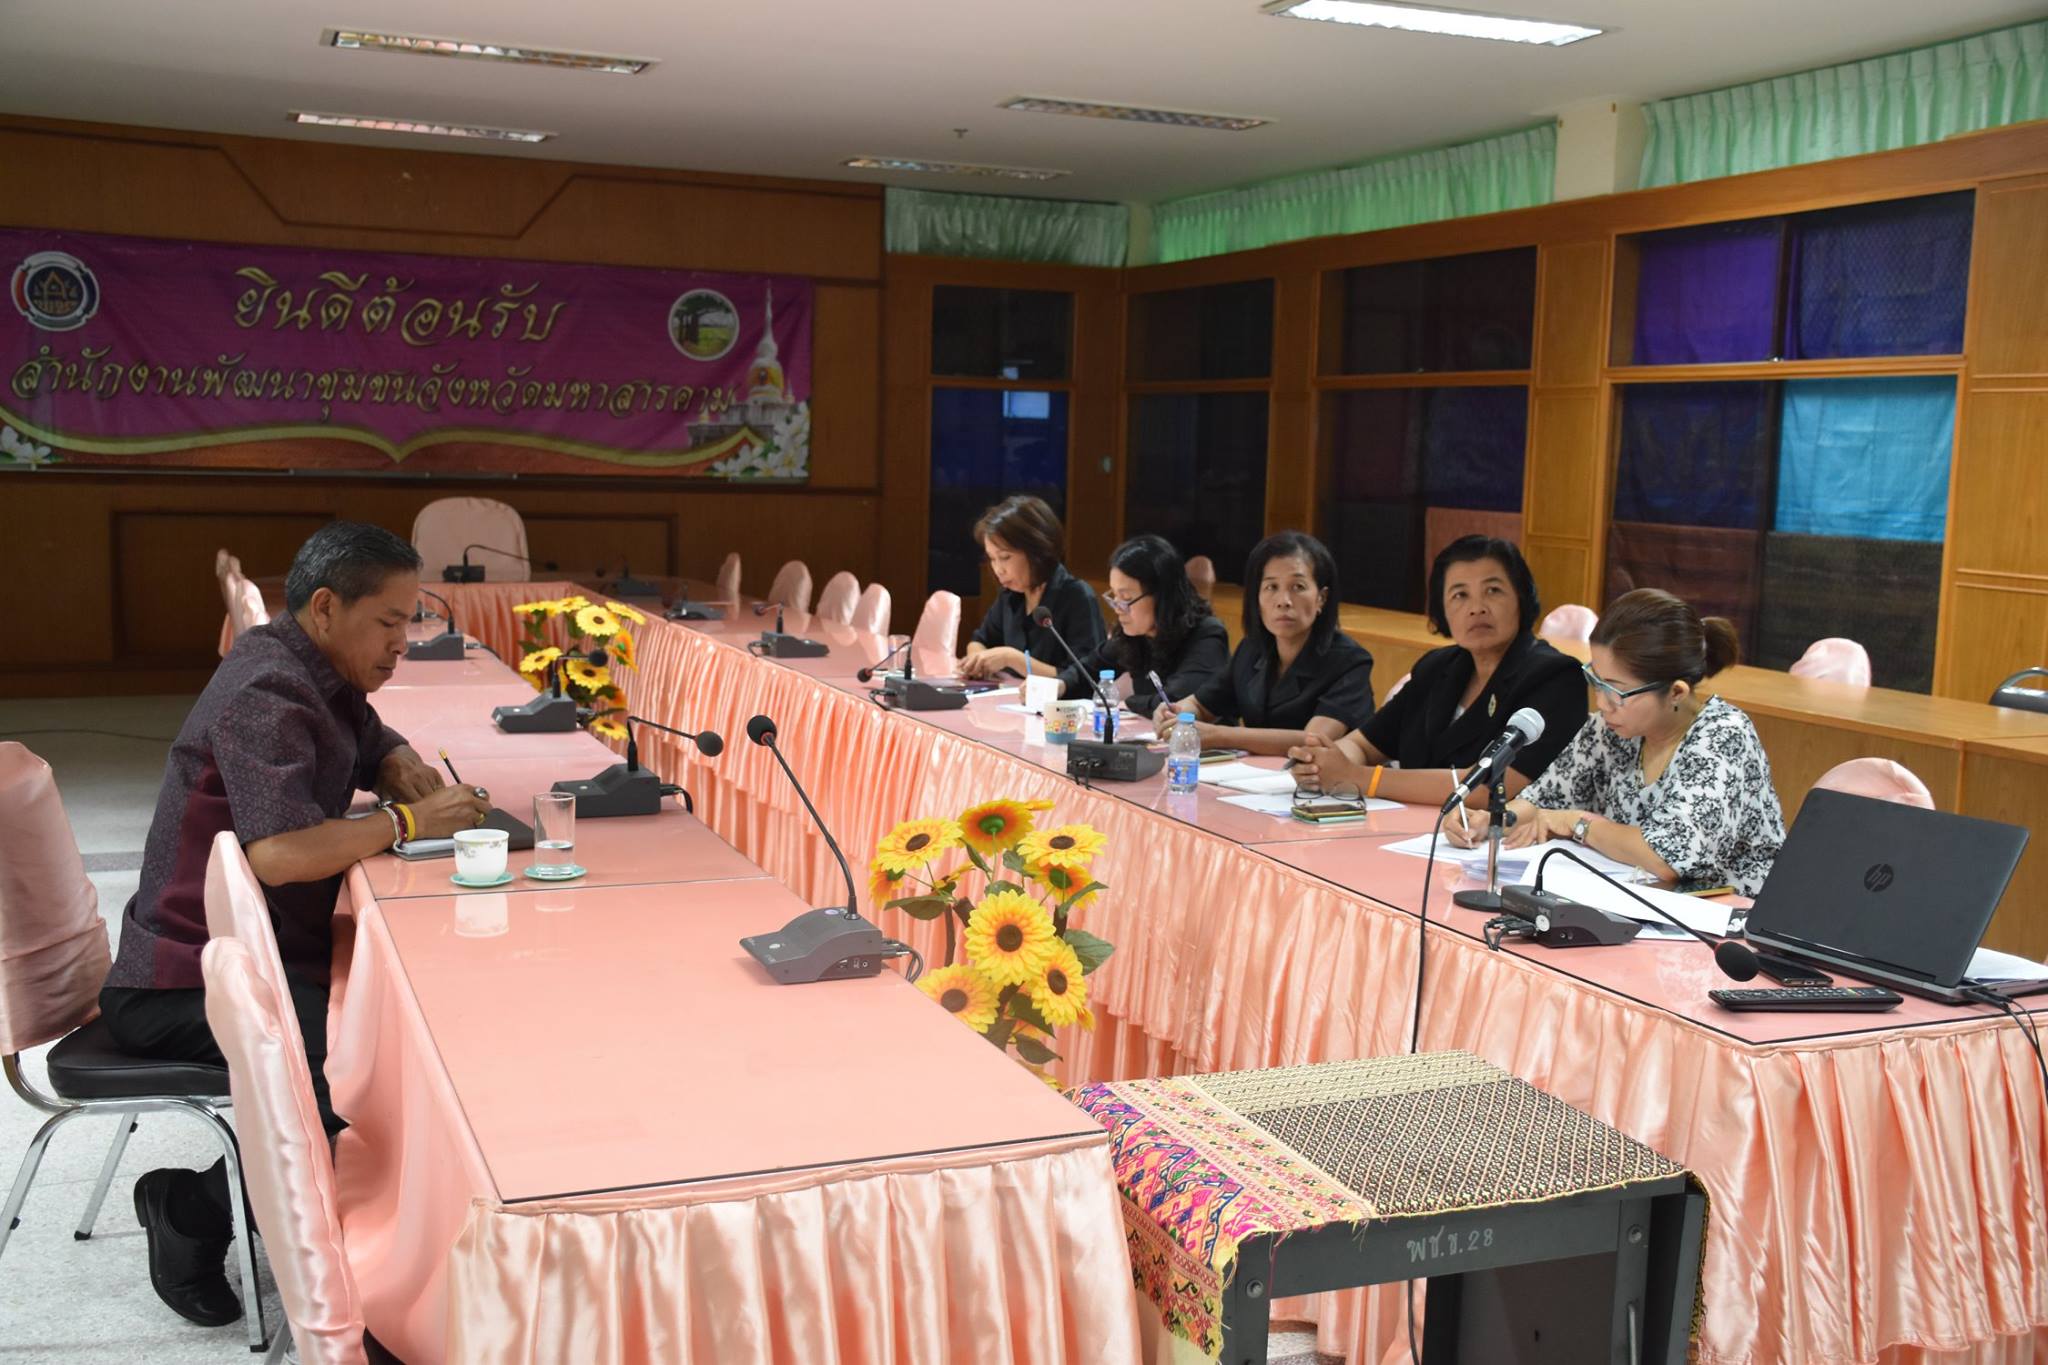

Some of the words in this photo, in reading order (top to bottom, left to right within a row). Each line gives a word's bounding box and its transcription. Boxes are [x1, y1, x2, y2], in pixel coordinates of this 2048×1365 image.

[234, 267, 566, 346] ยินดีต้อนรับ
[11, 345, 735, 421] สำนักงานพัฒนาชุมชนจังหวัดมหาสารคาม
[1867, 864, 1892, 891] hp
